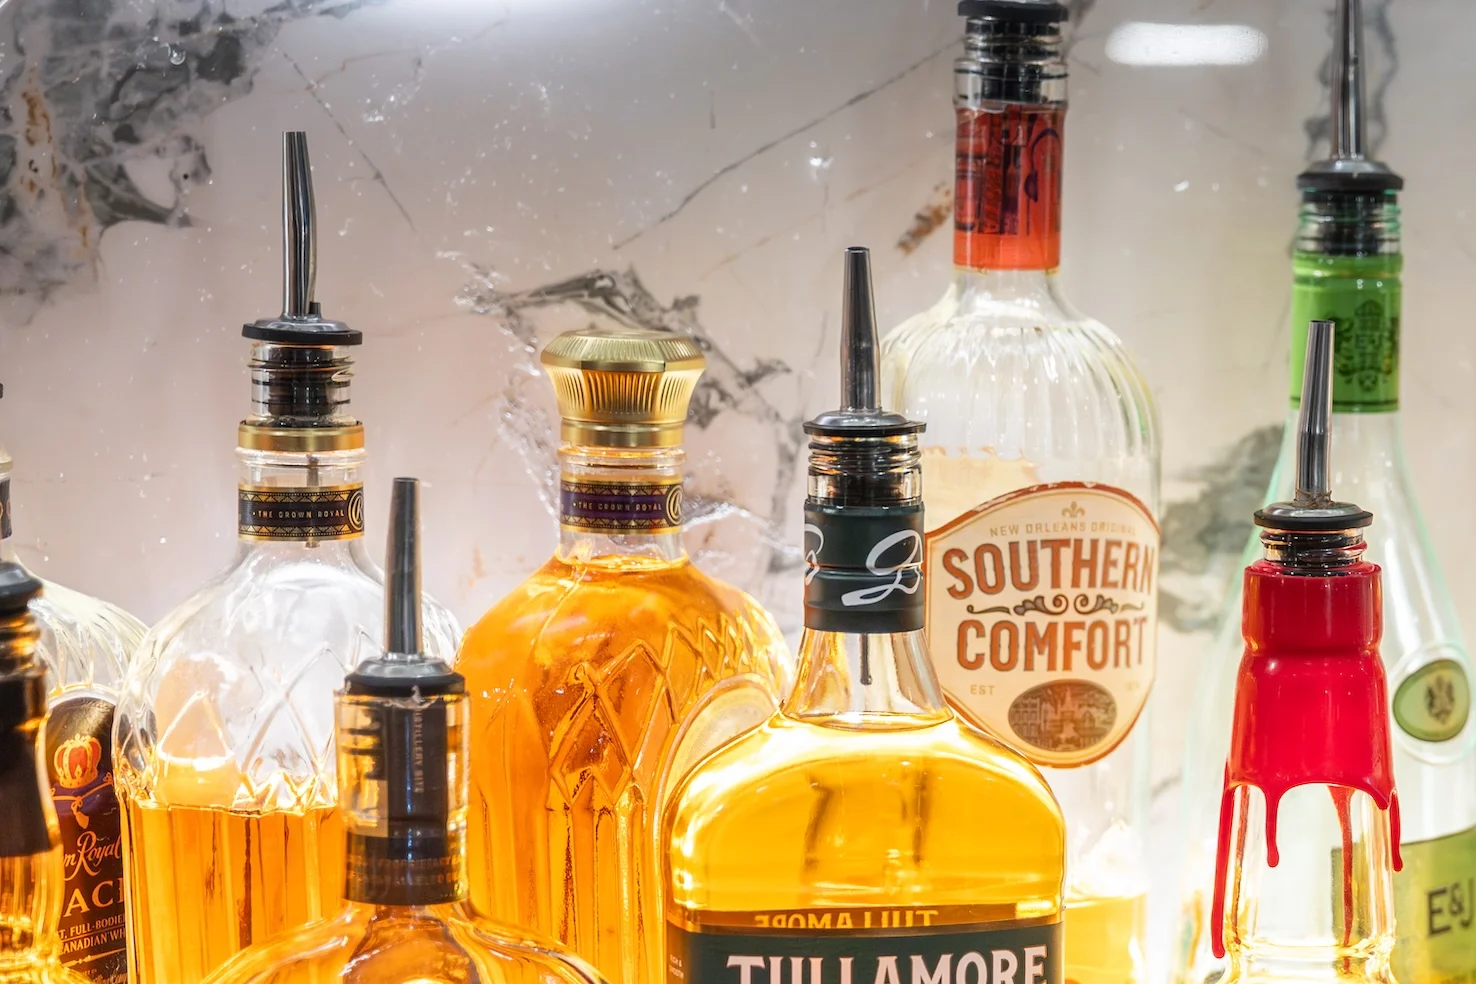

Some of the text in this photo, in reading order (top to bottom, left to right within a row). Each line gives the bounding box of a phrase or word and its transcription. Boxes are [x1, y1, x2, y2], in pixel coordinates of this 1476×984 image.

[318, 510, 344, 518] ROYAL
[578, 501, 662, 511] THE CROWN ROYAL
[990, 521, 1136, 537] NEW ORLEANS ORIGINAL
[942, 538, 1154, 600] SOUTHERN
[957, 617, 1147, 673] COMFORT
[970, 684, 995, 696] EST
[64, 830, 121, 881] Royal
[1426, 878, 1476, 938] E&J
